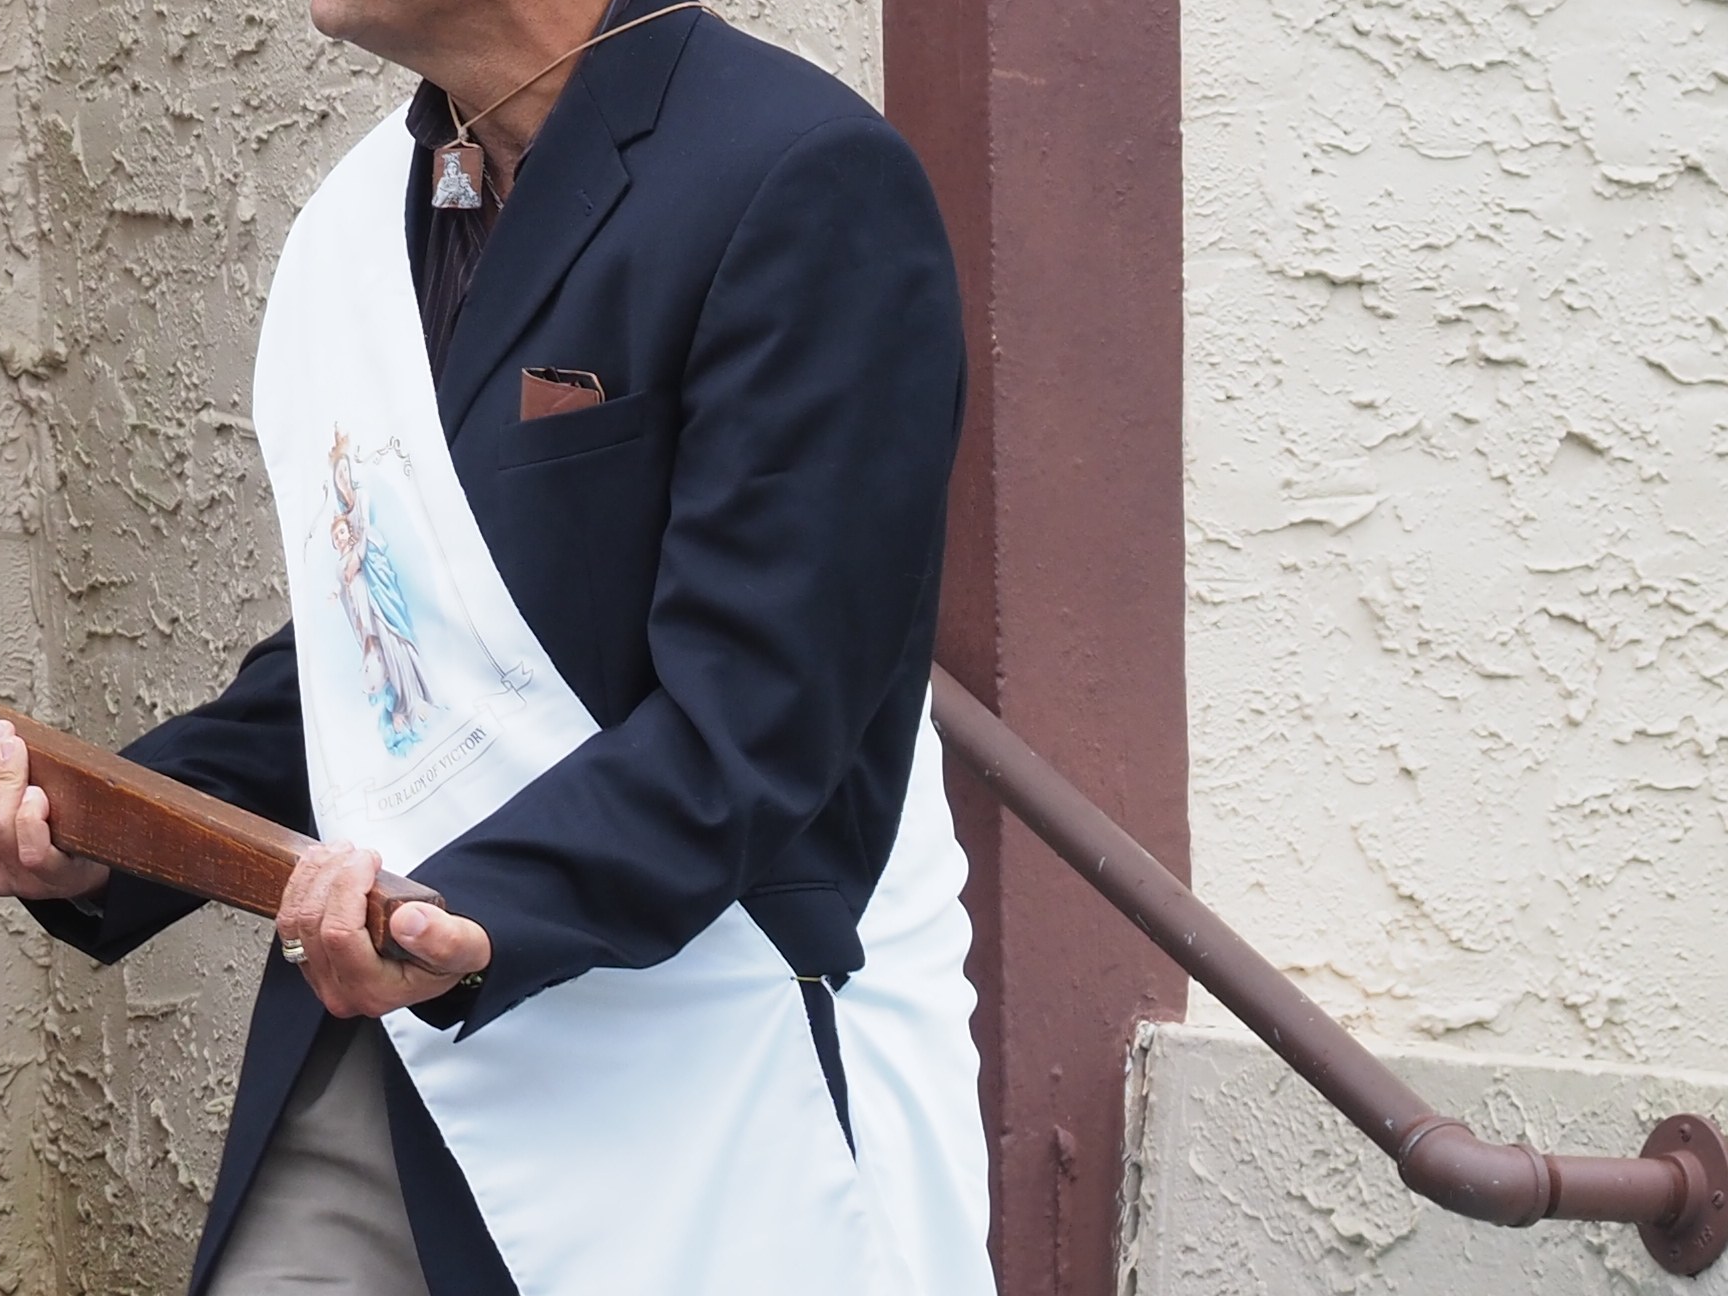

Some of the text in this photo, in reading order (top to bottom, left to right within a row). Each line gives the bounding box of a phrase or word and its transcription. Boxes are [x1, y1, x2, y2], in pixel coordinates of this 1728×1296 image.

[378, 725, 487, 811] OUR LADY OF VICTORY
